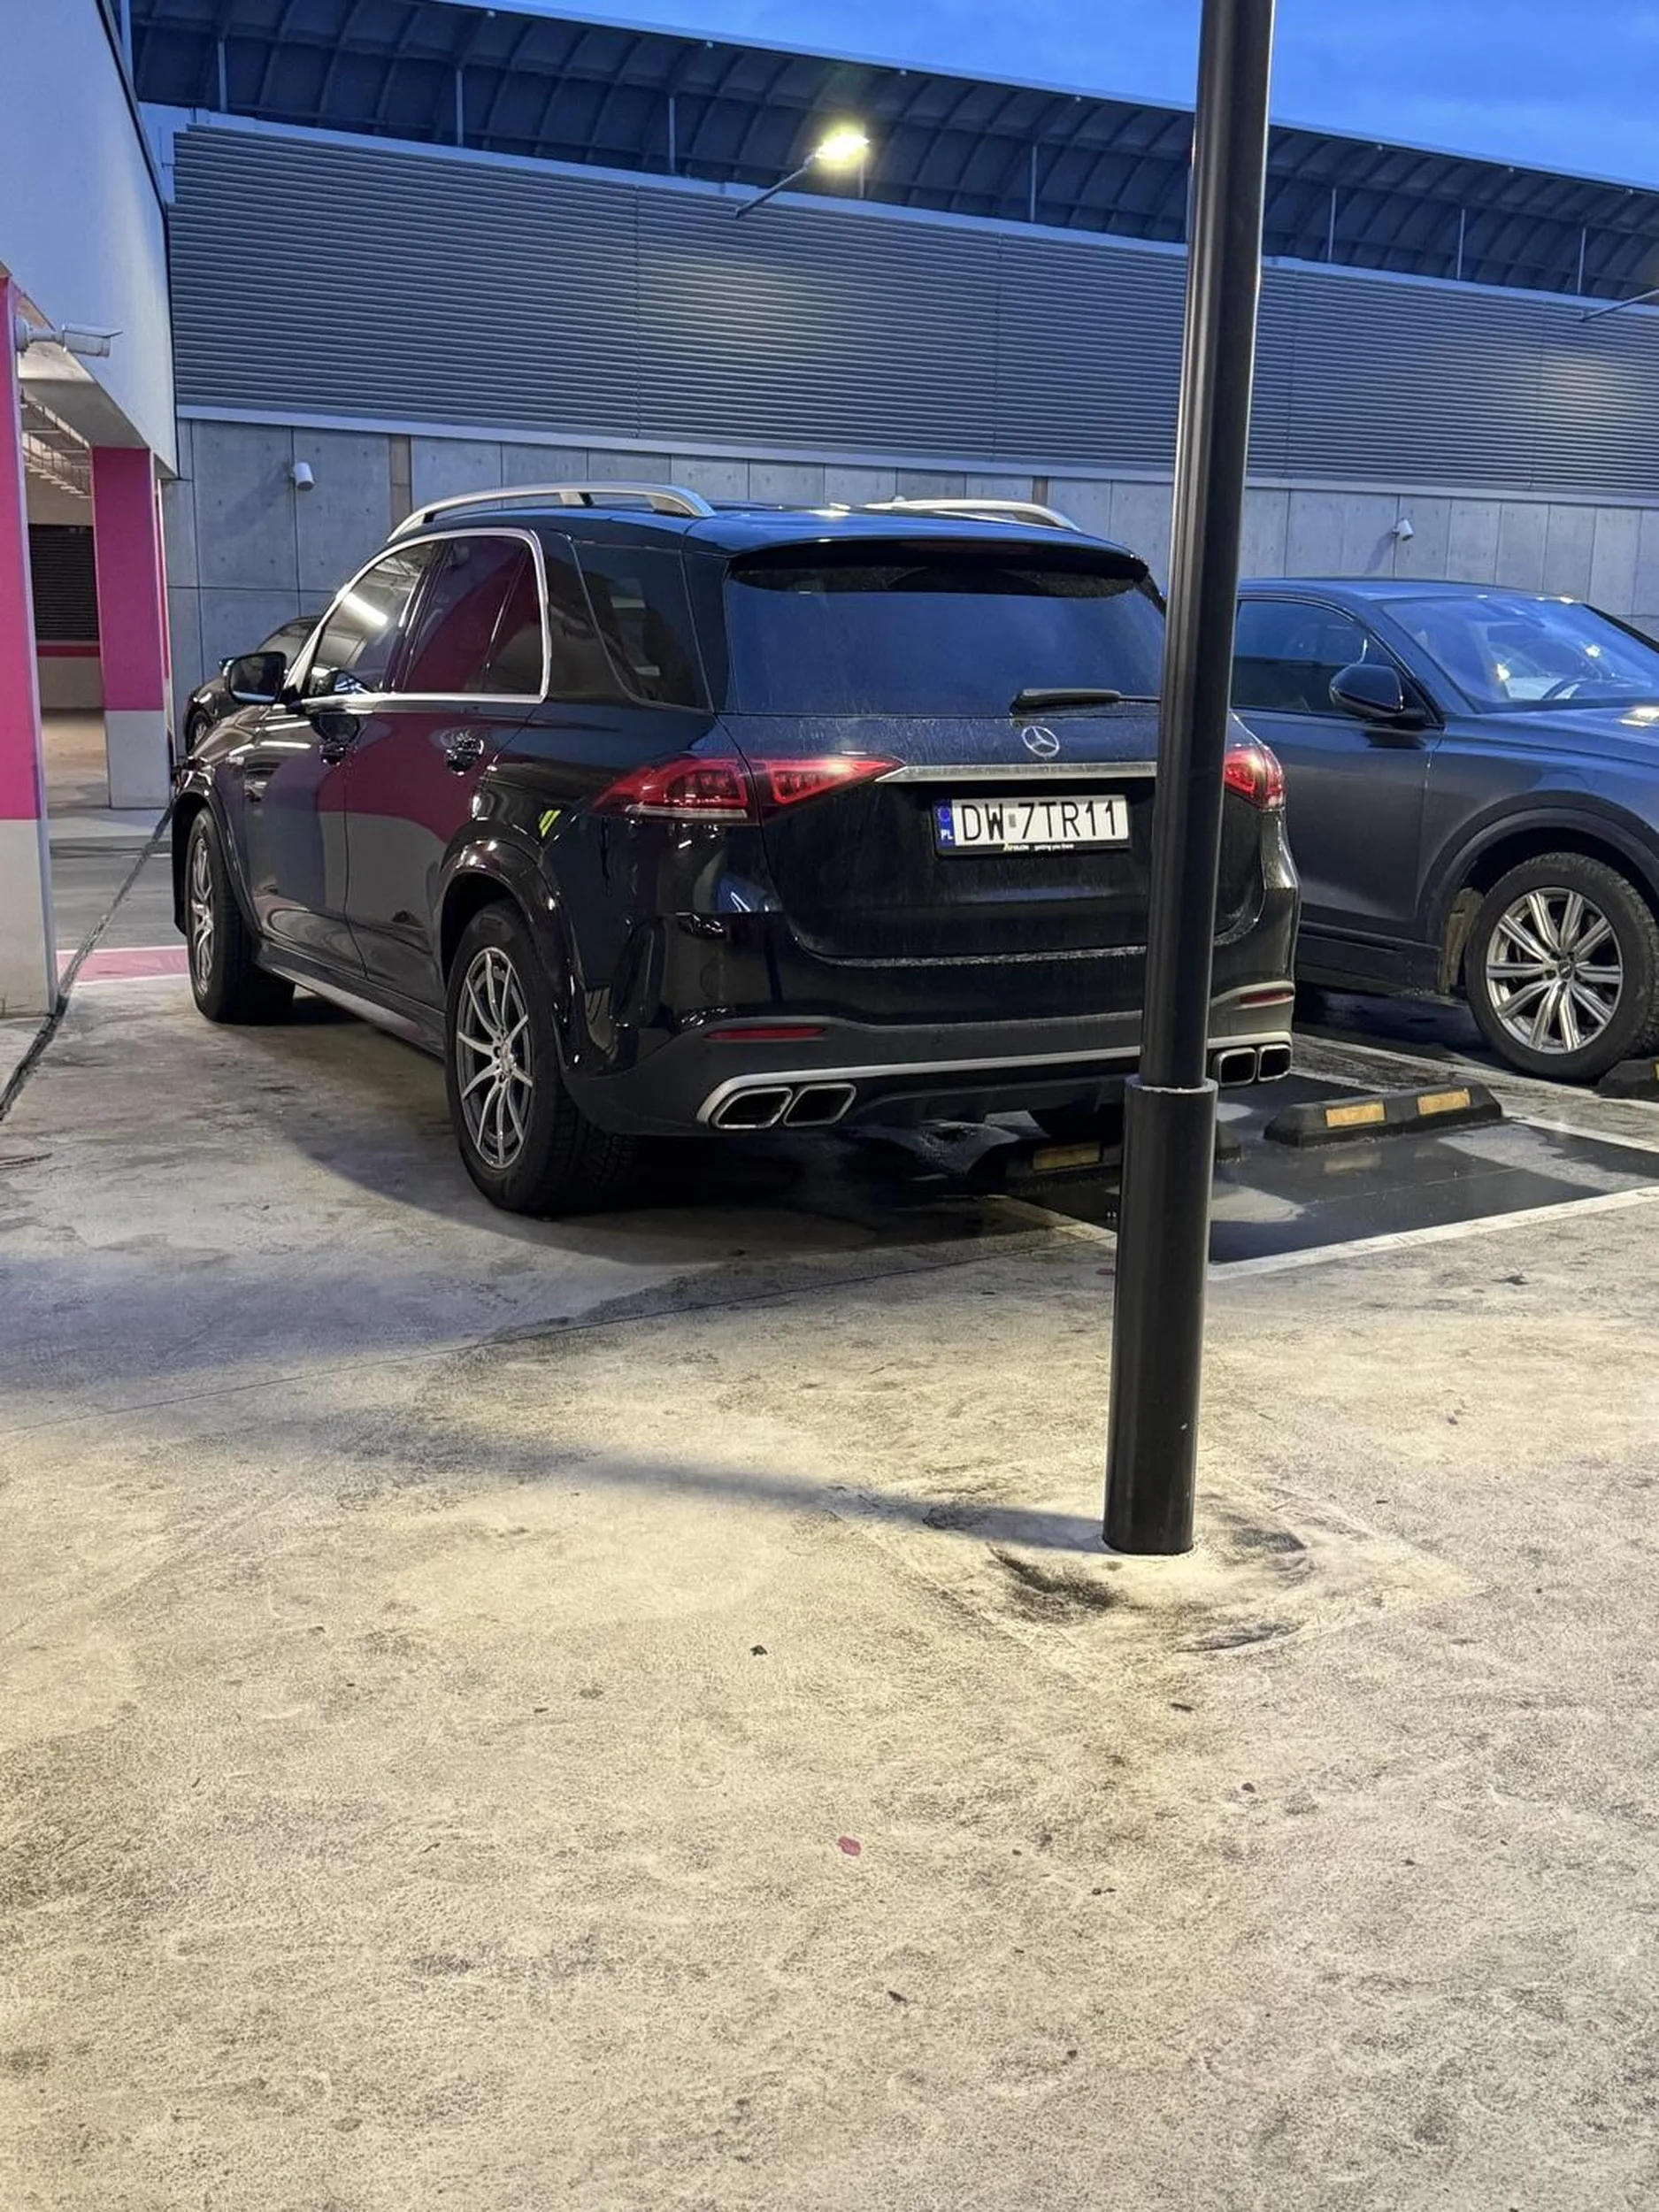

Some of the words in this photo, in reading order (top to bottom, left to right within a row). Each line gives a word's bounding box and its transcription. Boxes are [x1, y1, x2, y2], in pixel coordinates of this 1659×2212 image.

[962, 803, 1004, 841] DW
[1018, 800, 1116, 840] 7TR11
[941, 829, 954, 841] PL
